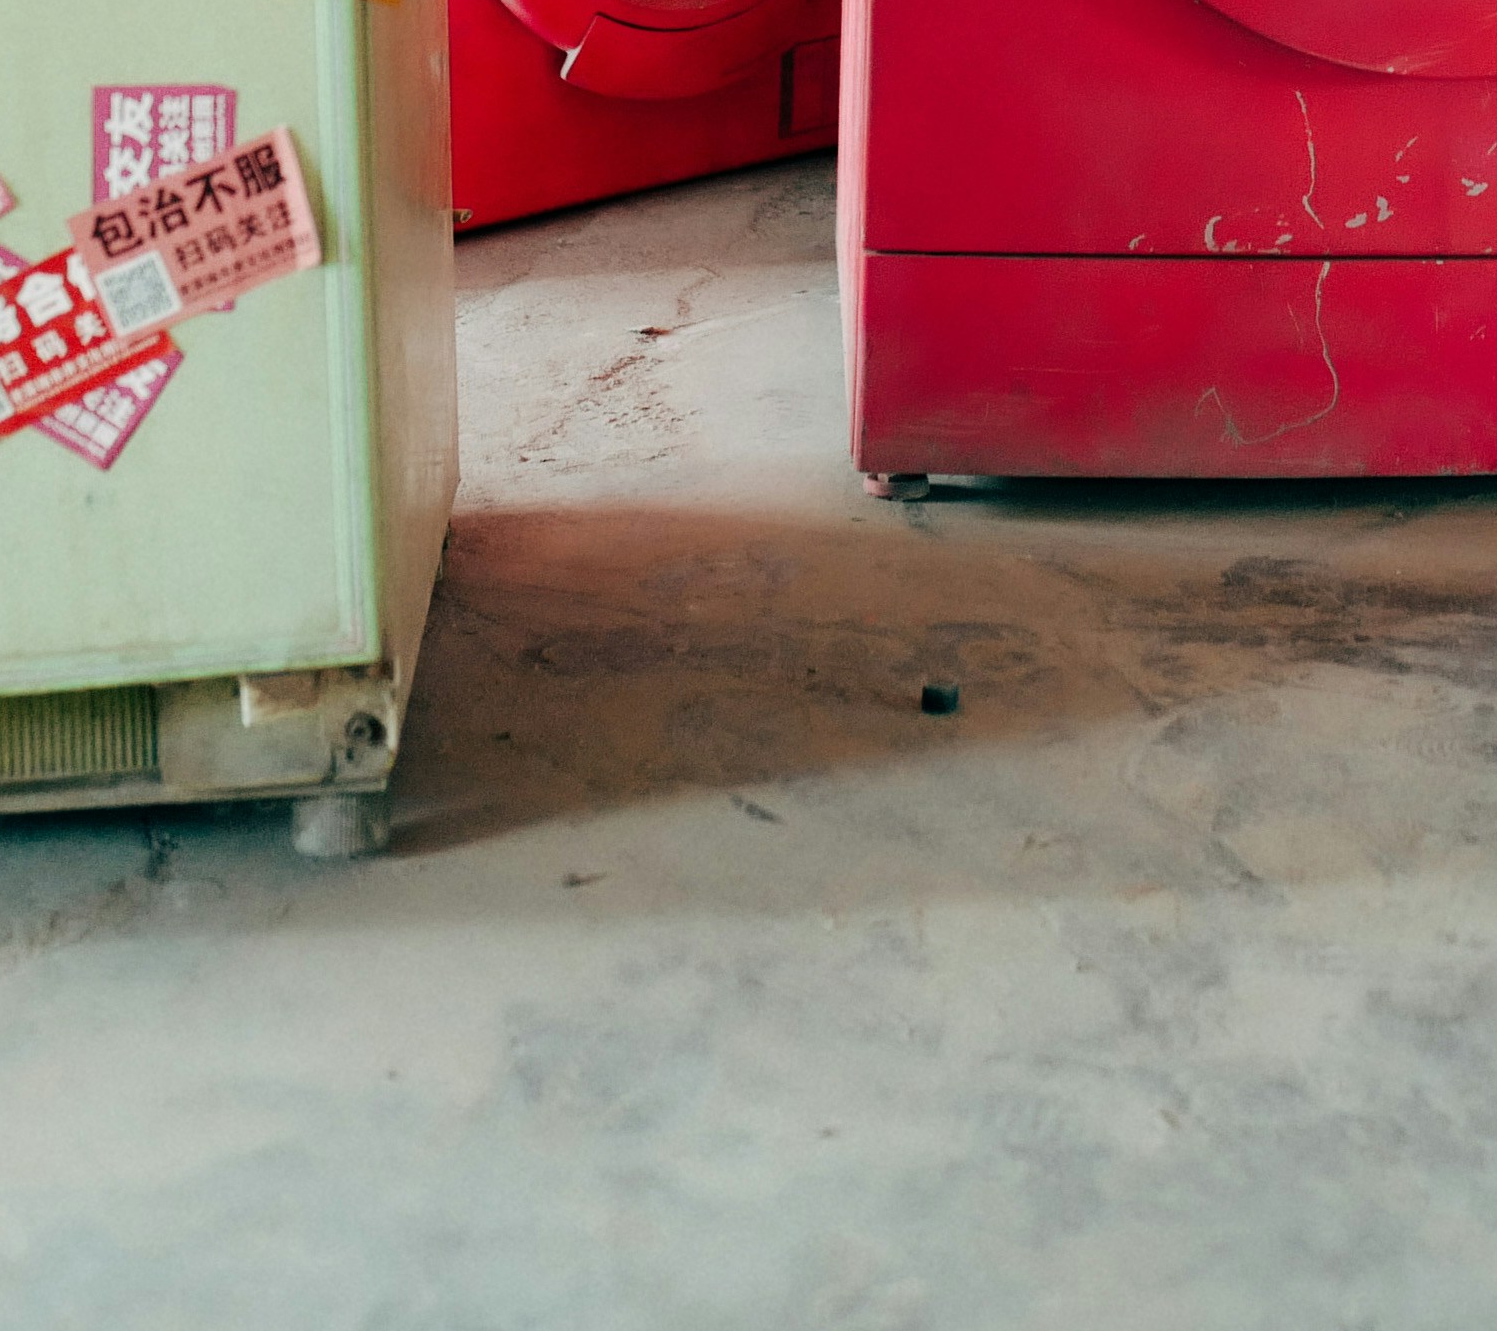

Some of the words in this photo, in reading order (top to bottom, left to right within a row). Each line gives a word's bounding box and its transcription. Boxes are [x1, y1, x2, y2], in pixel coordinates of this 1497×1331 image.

[104, 91, 154, 198] 交友
[89, 141, 285, 260] 包治不服
[174, 200, 293, 274] 扫码关注
